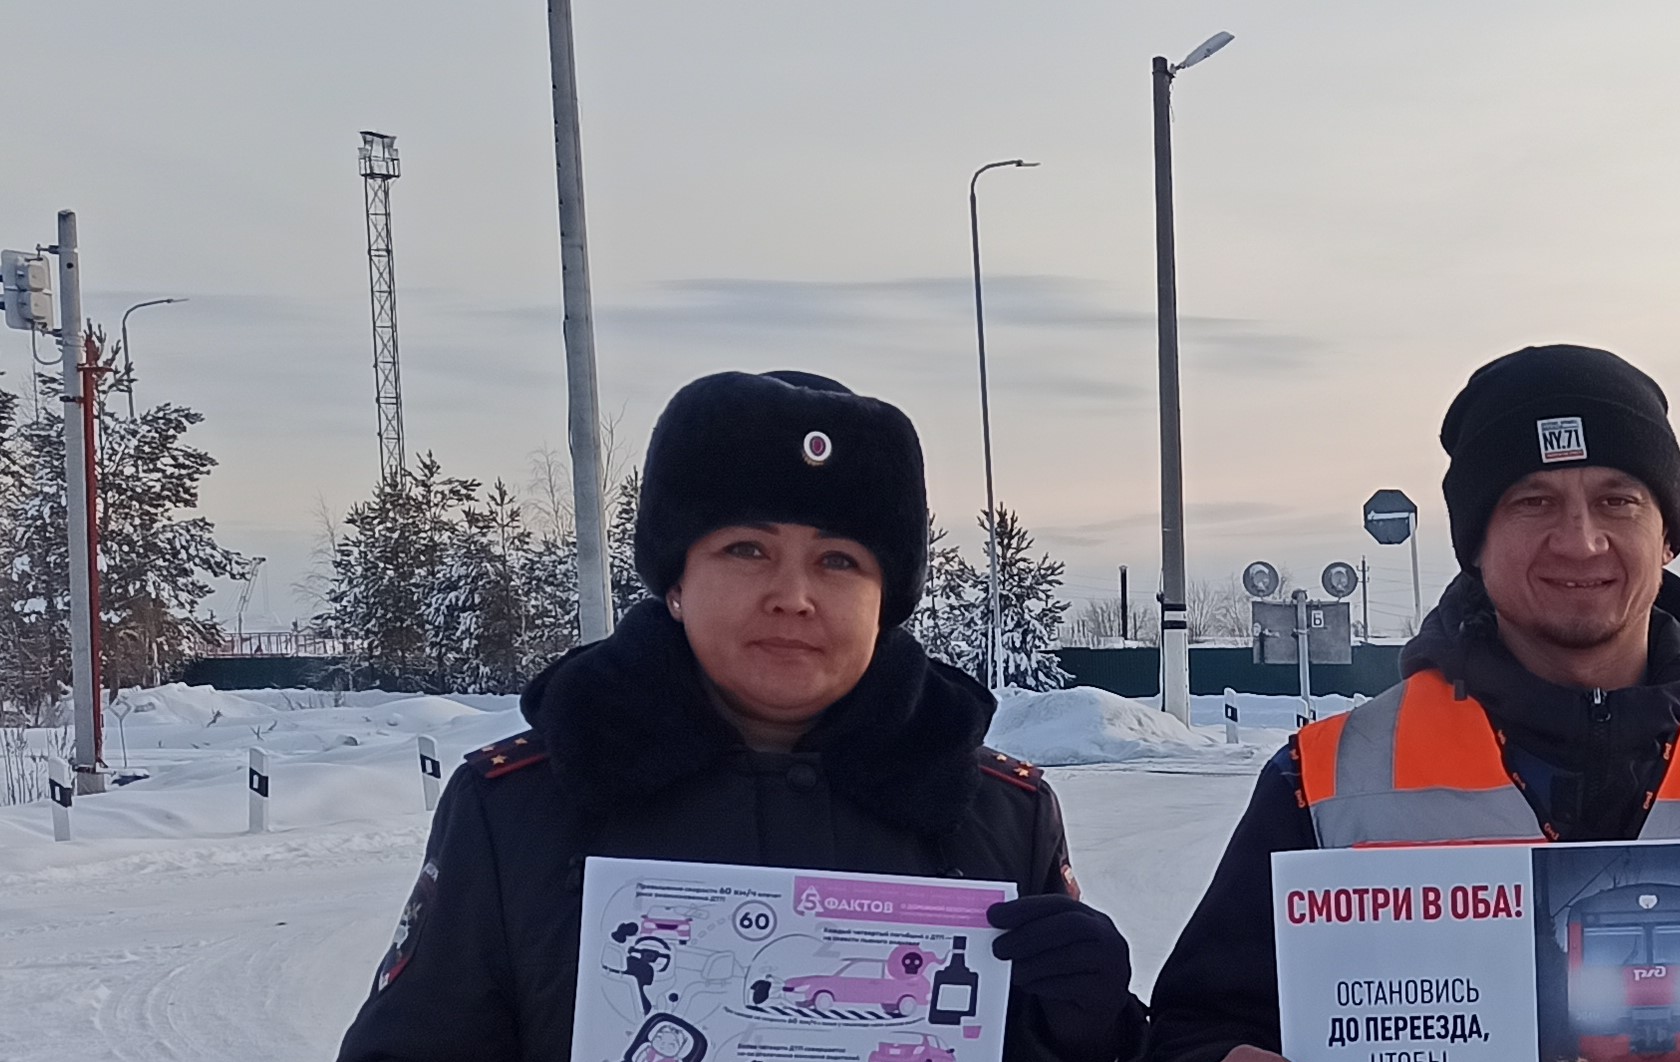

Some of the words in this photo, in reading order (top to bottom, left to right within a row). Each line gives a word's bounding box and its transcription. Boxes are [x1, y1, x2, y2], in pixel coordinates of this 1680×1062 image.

[1542, 429, 1581, 451] NY.71
[803, 893, 817, 911] 5
[823, 897, 894, 914] ФАКТОВ
[1287, 887, 1413, 925] СМОТРИ
[1422, 886, 1442, 920] В
[1450, 884, 1523, 920] ОБА!
[738, 911, 770, 931] 60
[1337, 978, 1480, 1006] ОСТАНОВИСЬ
[1328, 1016, 1359, 1047] ДО
[1365, 1013, 1490, 1044] ПЕРЕЕЗДА,
